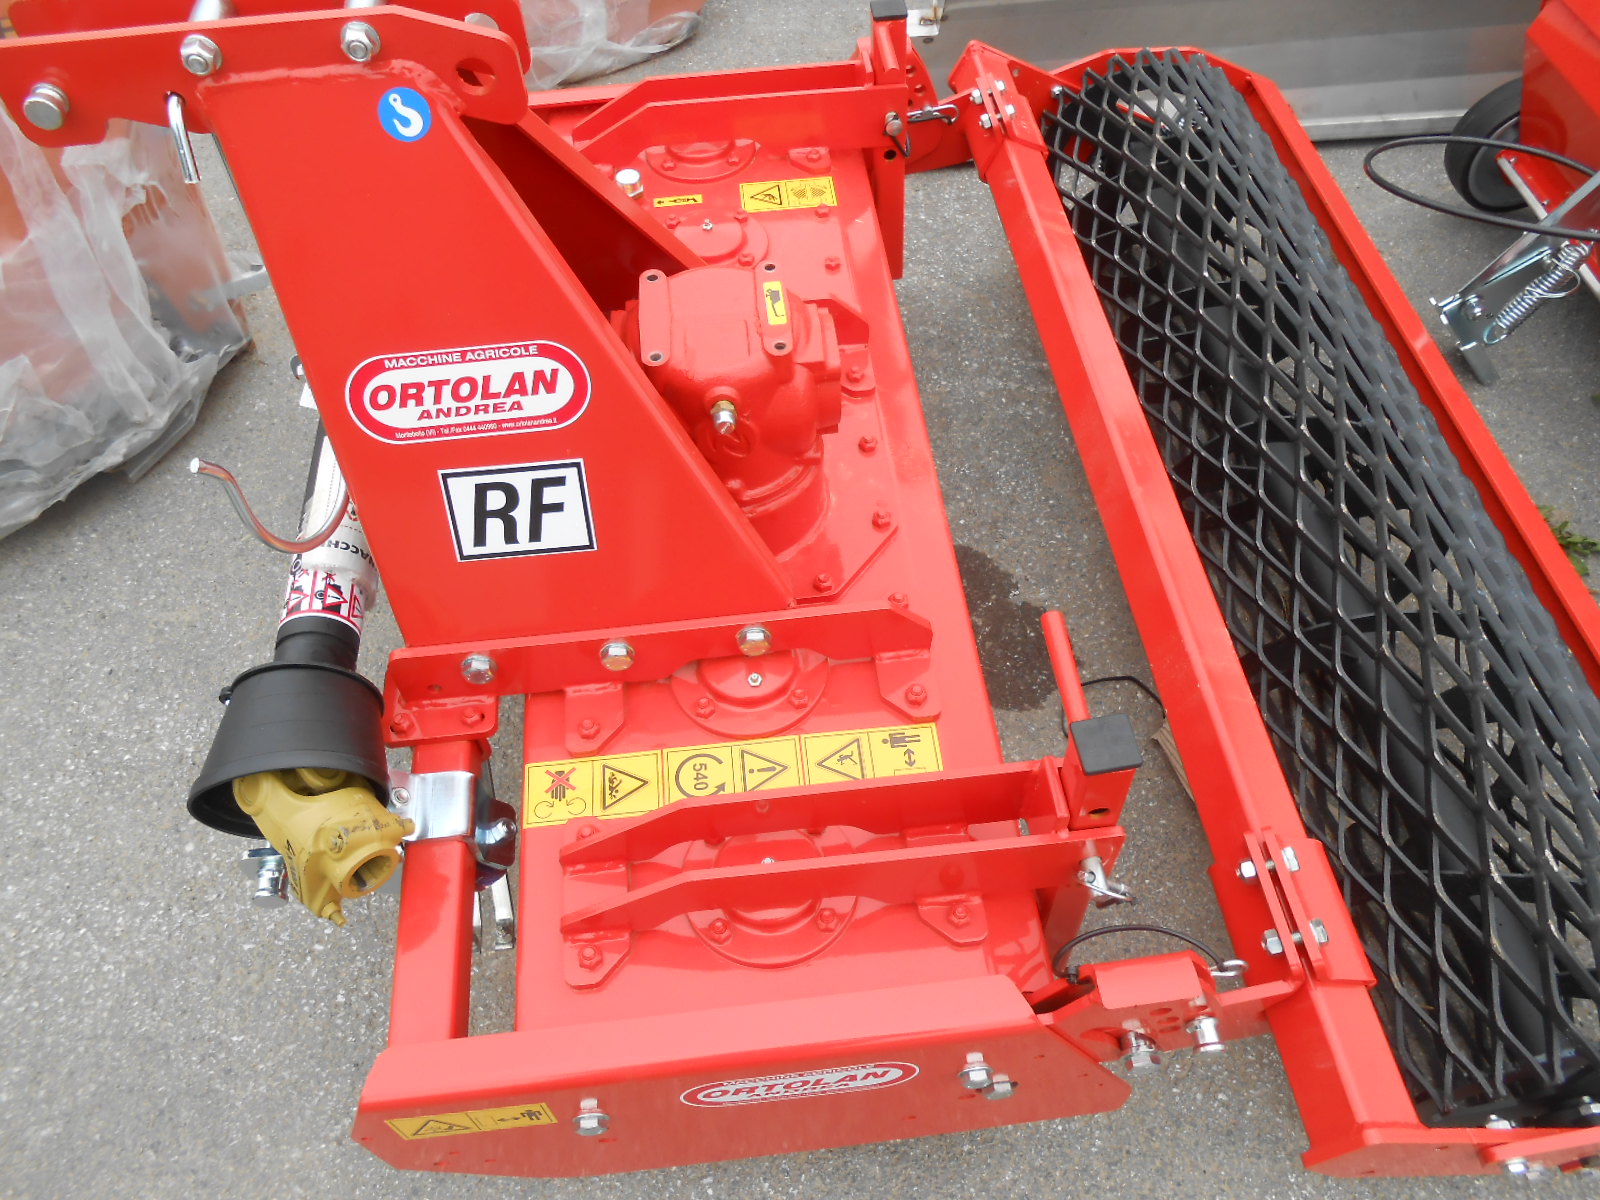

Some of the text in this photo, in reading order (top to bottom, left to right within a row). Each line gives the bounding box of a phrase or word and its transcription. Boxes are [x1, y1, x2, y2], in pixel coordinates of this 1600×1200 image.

[384, 345, 539, 369] MACCHINE AGRICOLE
[368, 368, 560, 411] ORTOLAN
[416, 400, 524, 421] ANDREA
[472, 475, 567, 548] RF
[692, 763, 709, 791] 540
[700, 1069, 892, 1099] ORTOLAN
